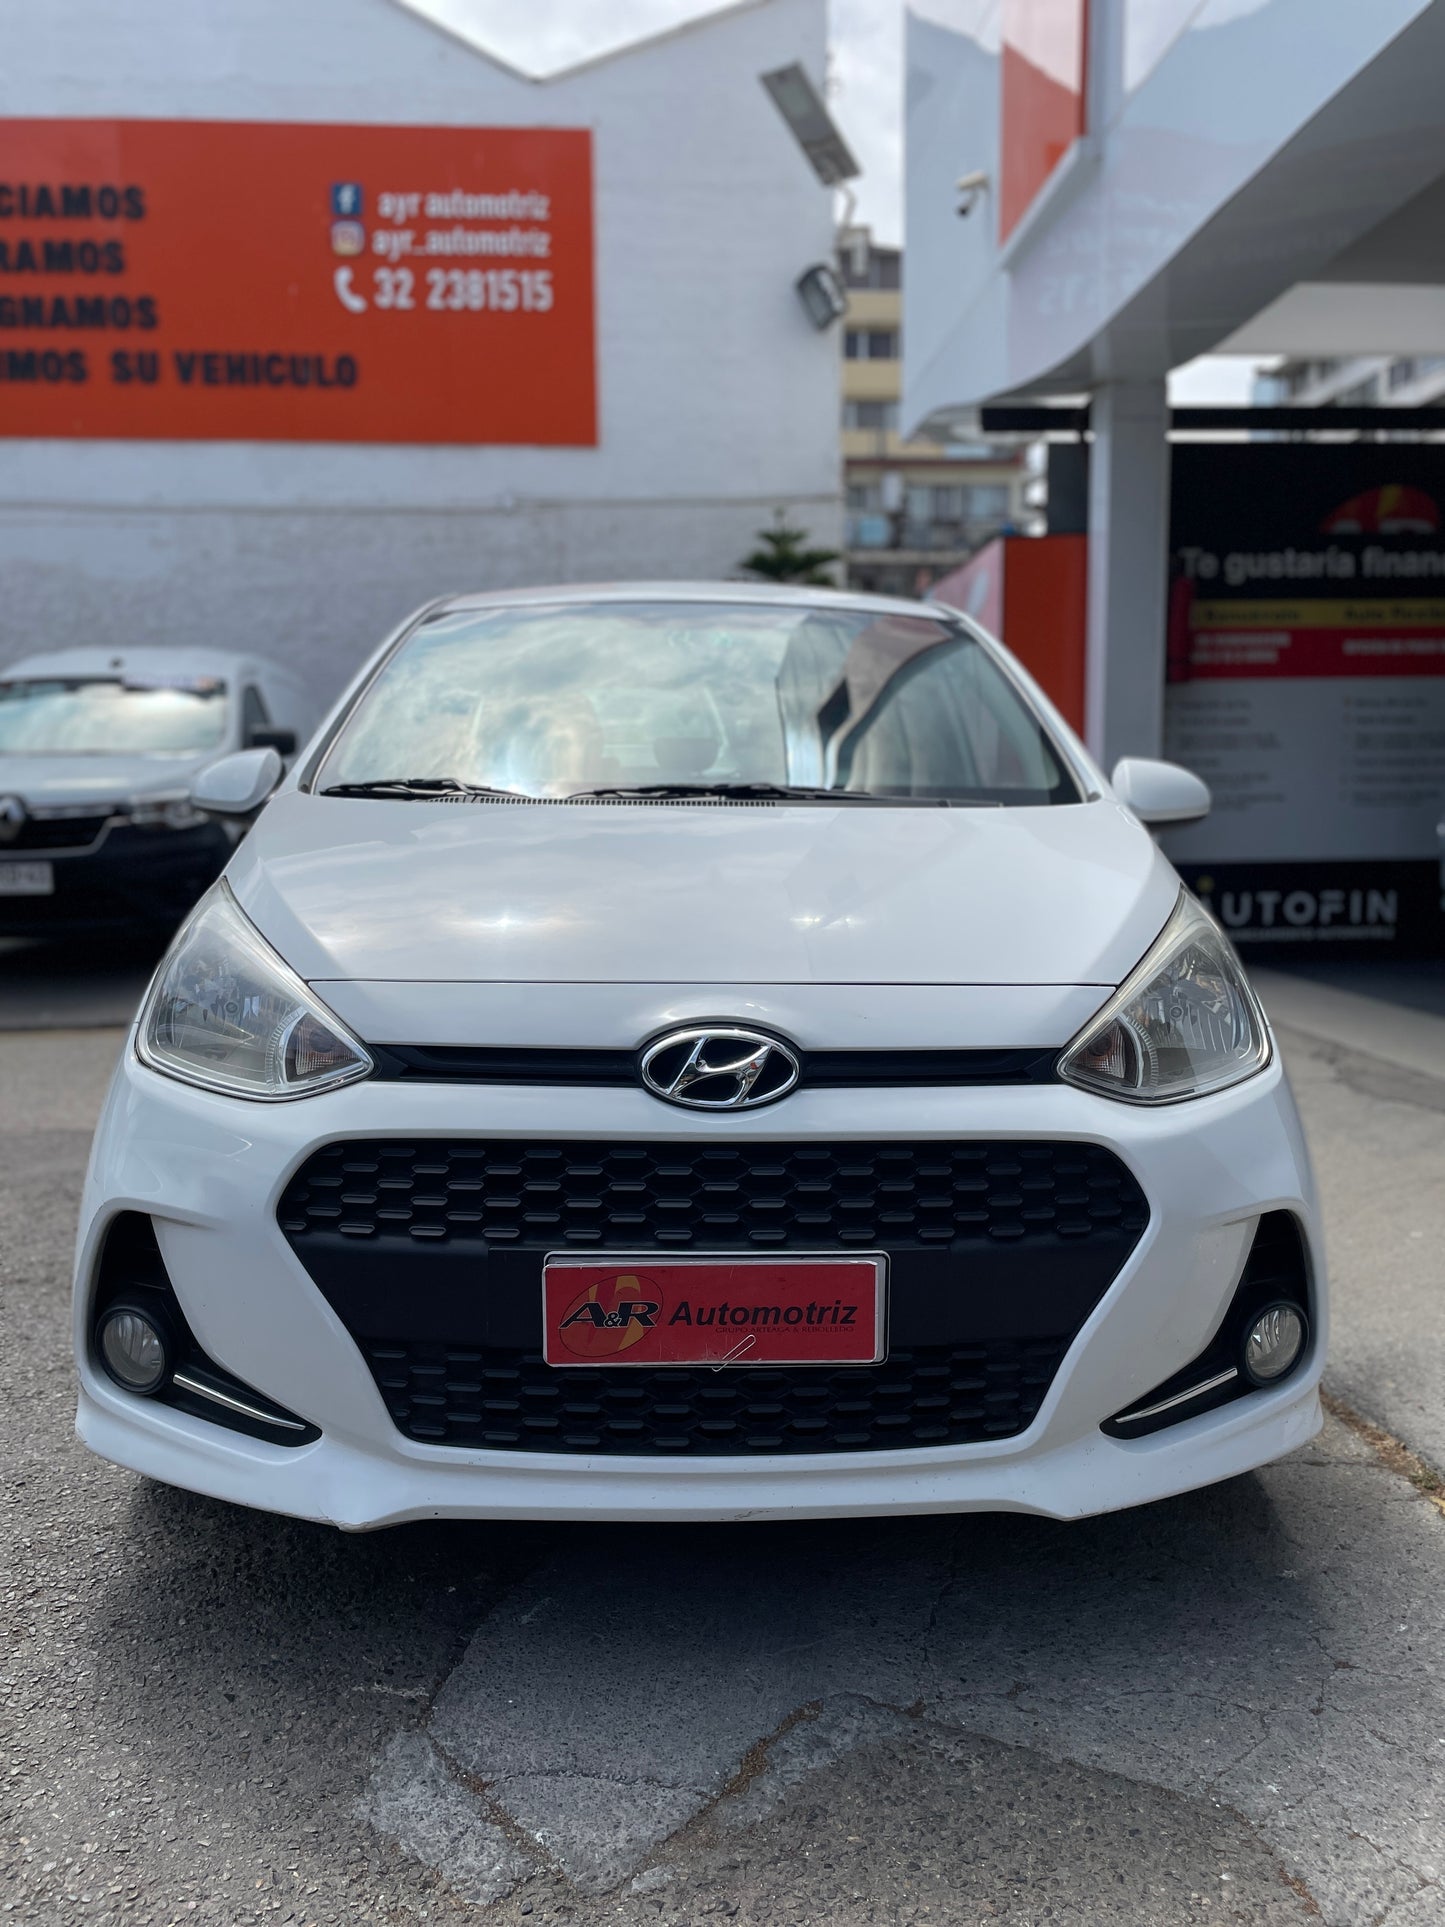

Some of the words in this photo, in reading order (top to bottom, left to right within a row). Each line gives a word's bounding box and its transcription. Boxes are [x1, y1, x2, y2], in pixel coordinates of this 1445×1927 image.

[377, 191, 422, 224] ayr
[425, 188, 551, 221] automotriz
[372, 226, 551, 262] ayr_automotriz
[373, 266, 416, 309] 32
[425, 267, 554, 311] 2381515
[112, 350, 160, 385] SU
[174, 351, 359, 388] VEHICULO
[1180, 547, 1219, 579] Te
[1206, 888, 1398, 927] UTOFIN
[558, 1300, 660, 1329] A&R
[668, 1300, 858, 1327] Automotriz
[715, 1326, 748, 1335] GRUPO
